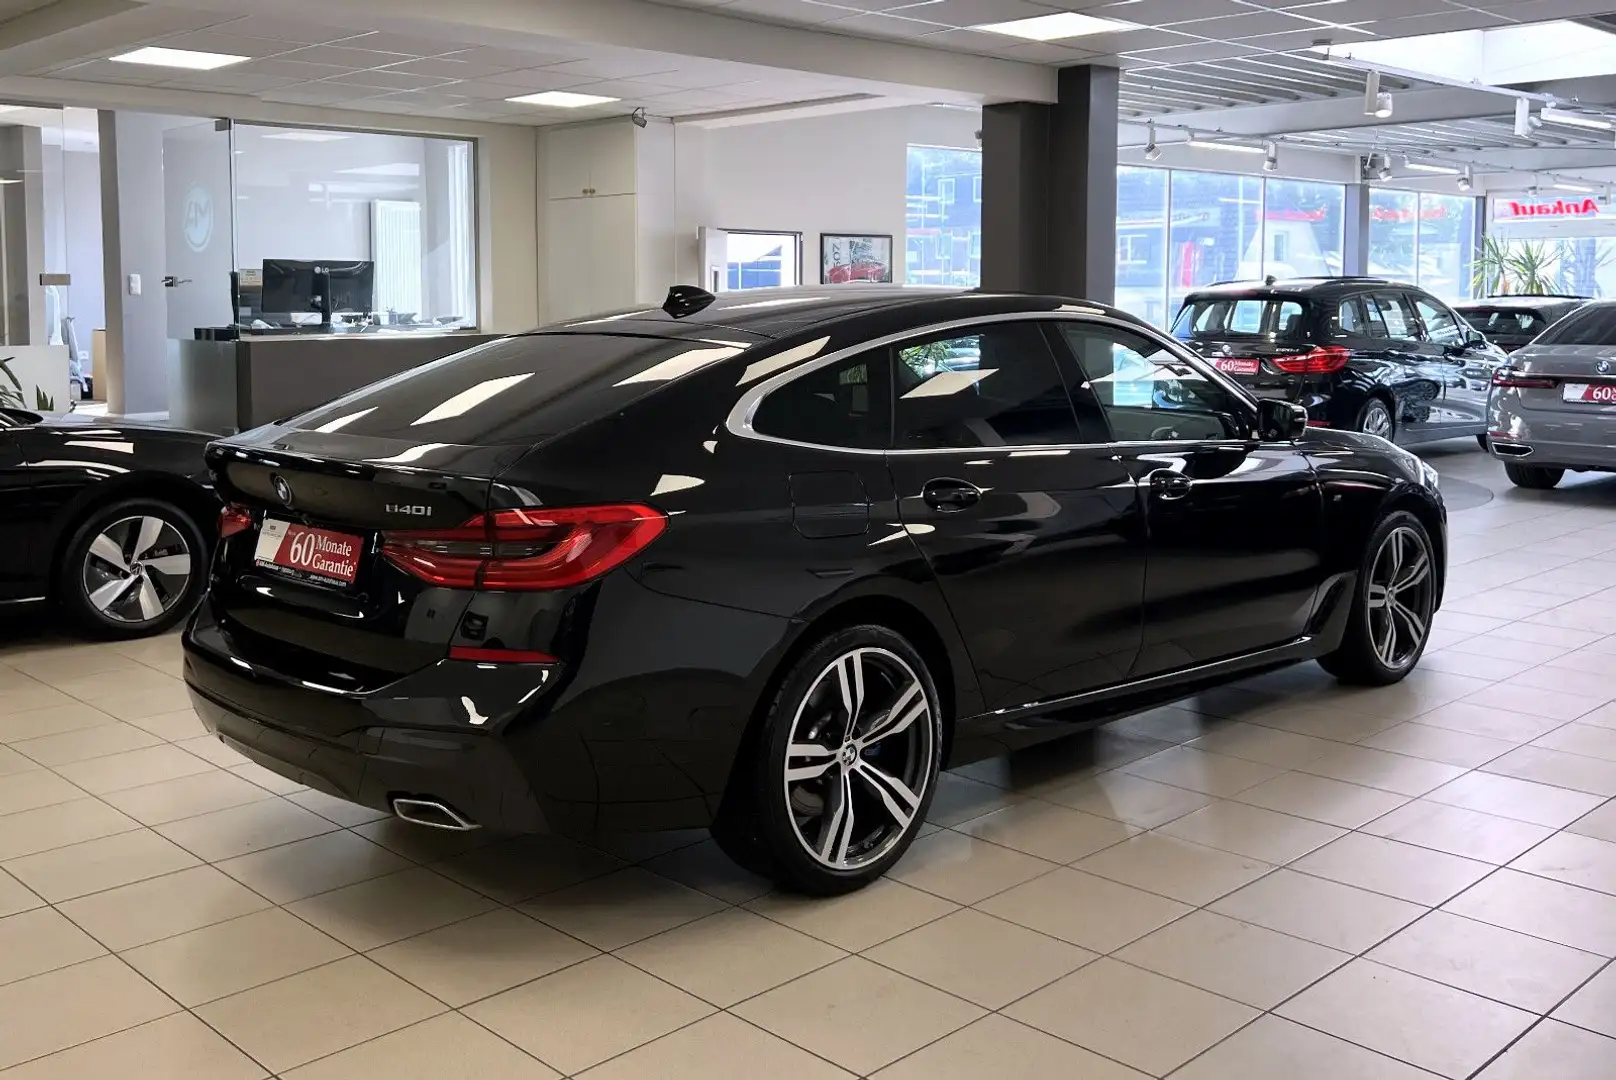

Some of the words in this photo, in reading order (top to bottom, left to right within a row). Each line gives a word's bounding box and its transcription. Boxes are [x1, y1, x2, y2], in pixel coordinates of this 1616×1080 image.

[1221, 360, 1234, 371] 60
[1592, 386, 1612, 401] 60
[290, 531, 315, 566] 60
[315, 535, 352, 557] Monate
